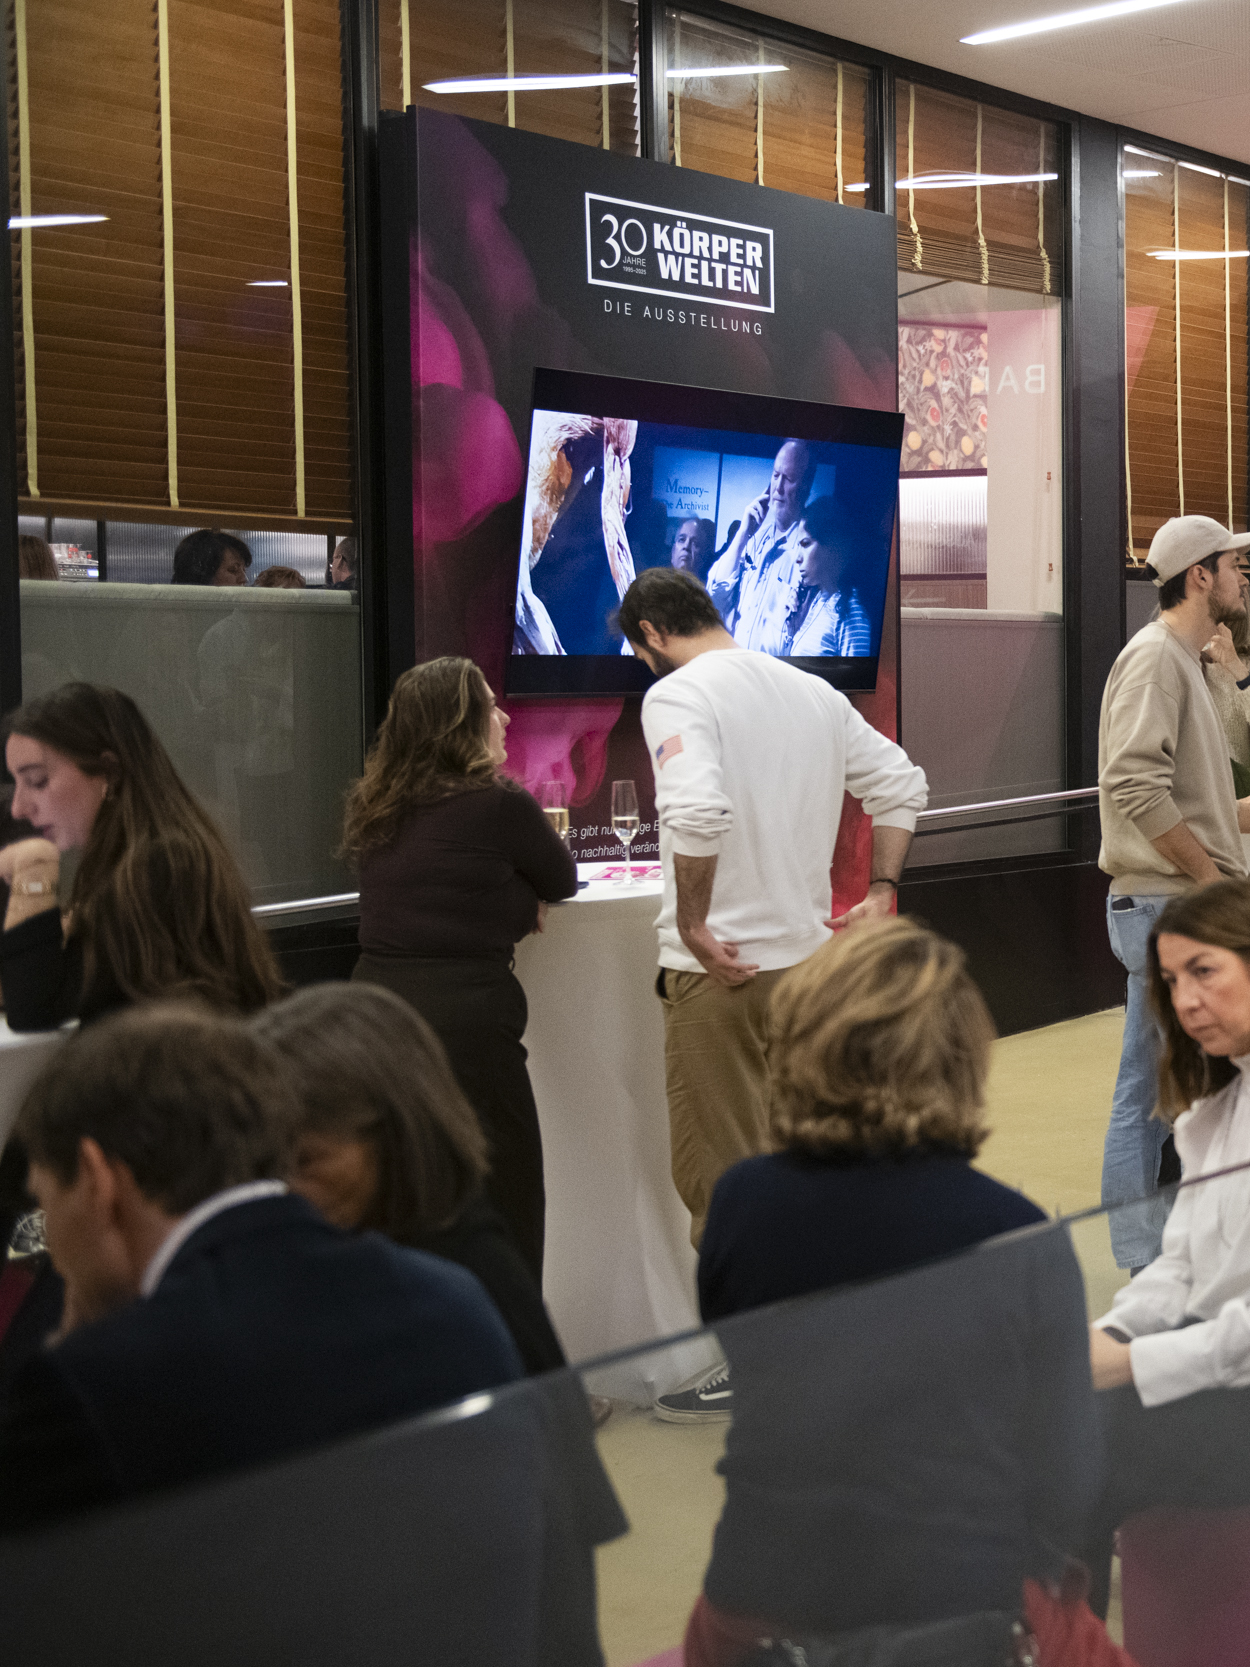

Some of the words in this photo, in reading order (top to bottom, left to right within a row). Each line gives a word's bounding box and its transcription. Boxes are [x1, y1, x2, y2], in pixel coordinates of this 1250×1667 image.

[600, 213, 647, 269] 30
[653, 220, 763, 268] KÖRPER
[622, 255, 647, 267] JAHRE
[657, 252, 760, 295] WELTEN
[604, 299, 632, 316] DIE
[643, 306, 762, 335] AUSSTELLUNG
[676, 497, 709, 511] Archivist
[580, 825, 599, 840] gibt
[581, 843, 627, 858] nachhaltig
